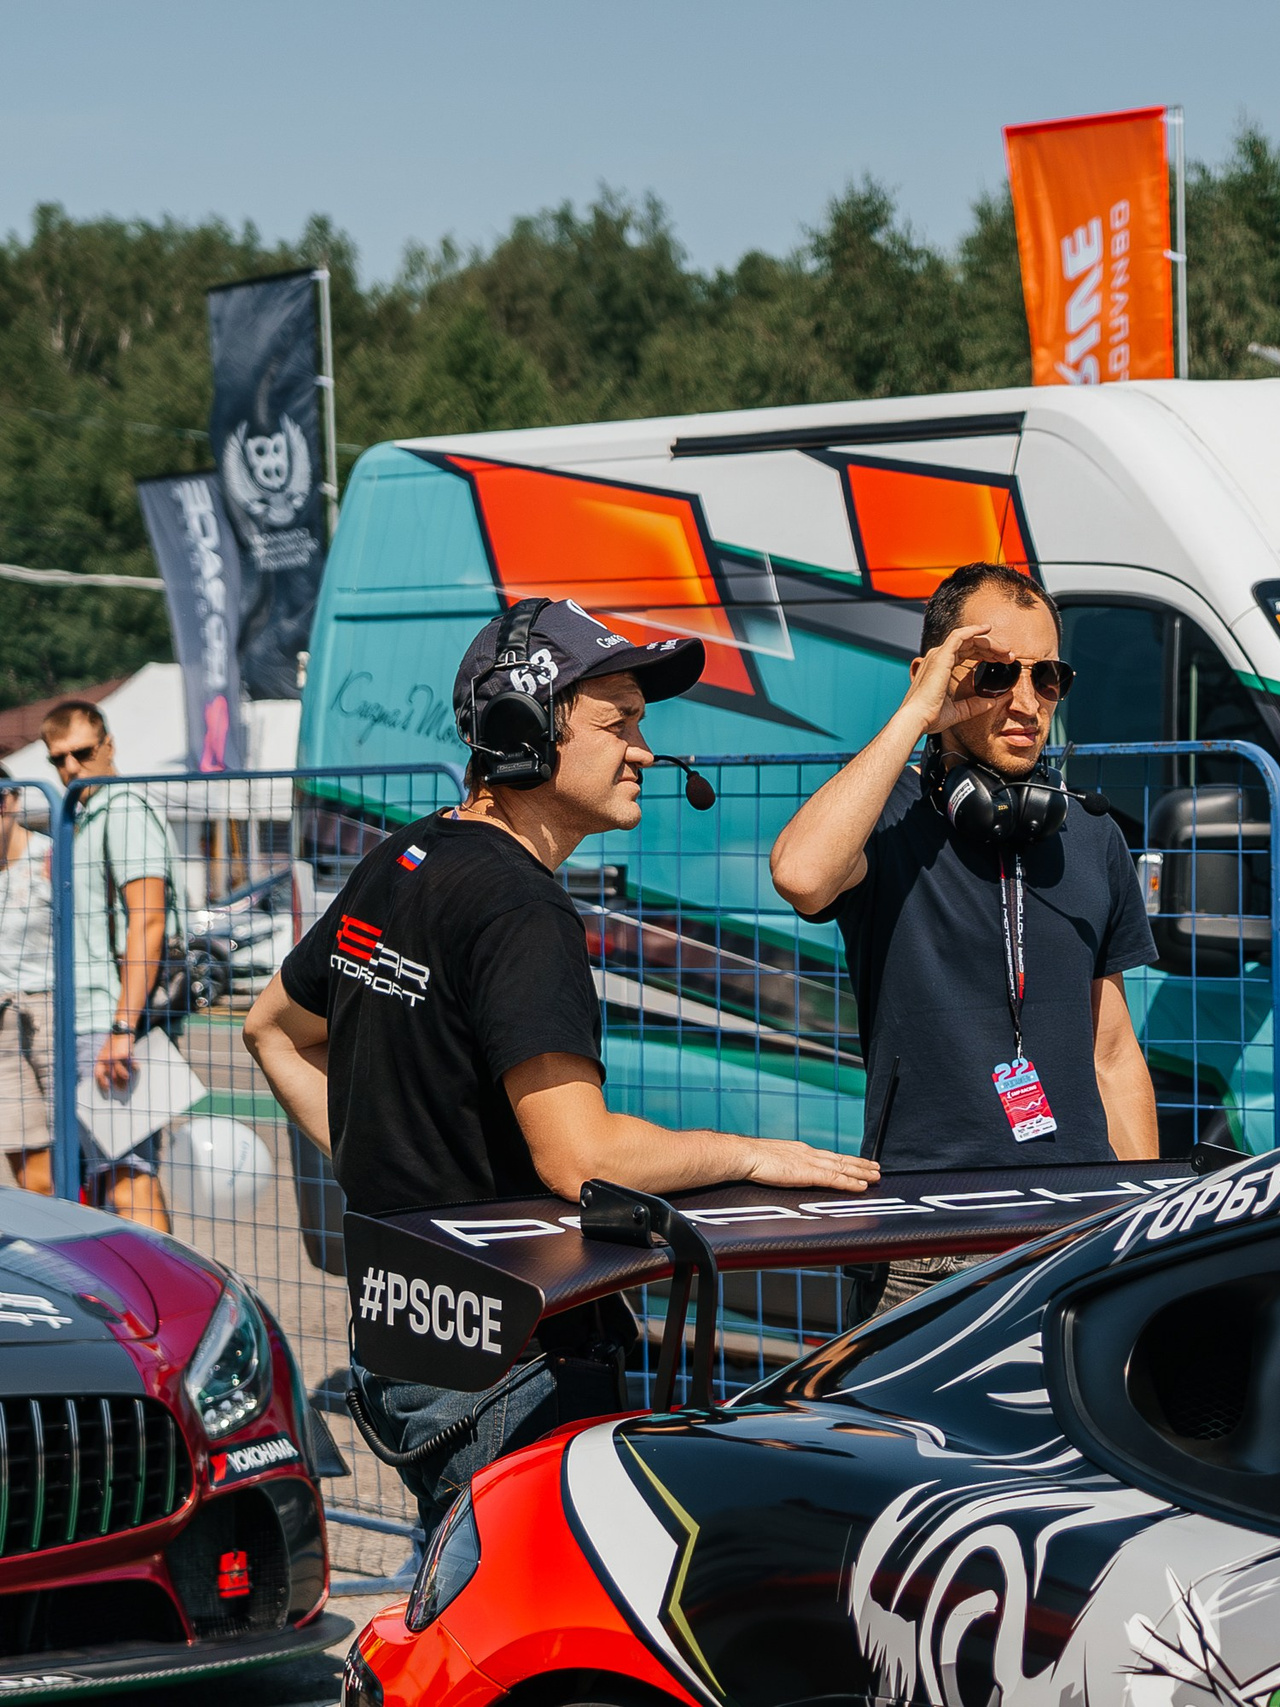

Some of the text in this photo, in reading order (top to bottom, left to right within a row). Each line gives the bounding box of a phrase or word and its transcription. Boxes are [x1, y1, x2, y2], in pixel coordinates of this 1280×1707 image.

[509, 648, 559, 697] 63
[430, 1175, 1199, 1247] PRSCH
[359, 1266, 502, 1355] #PSCCE
[226, 1438, 299, 1473] YOKOHAMA
